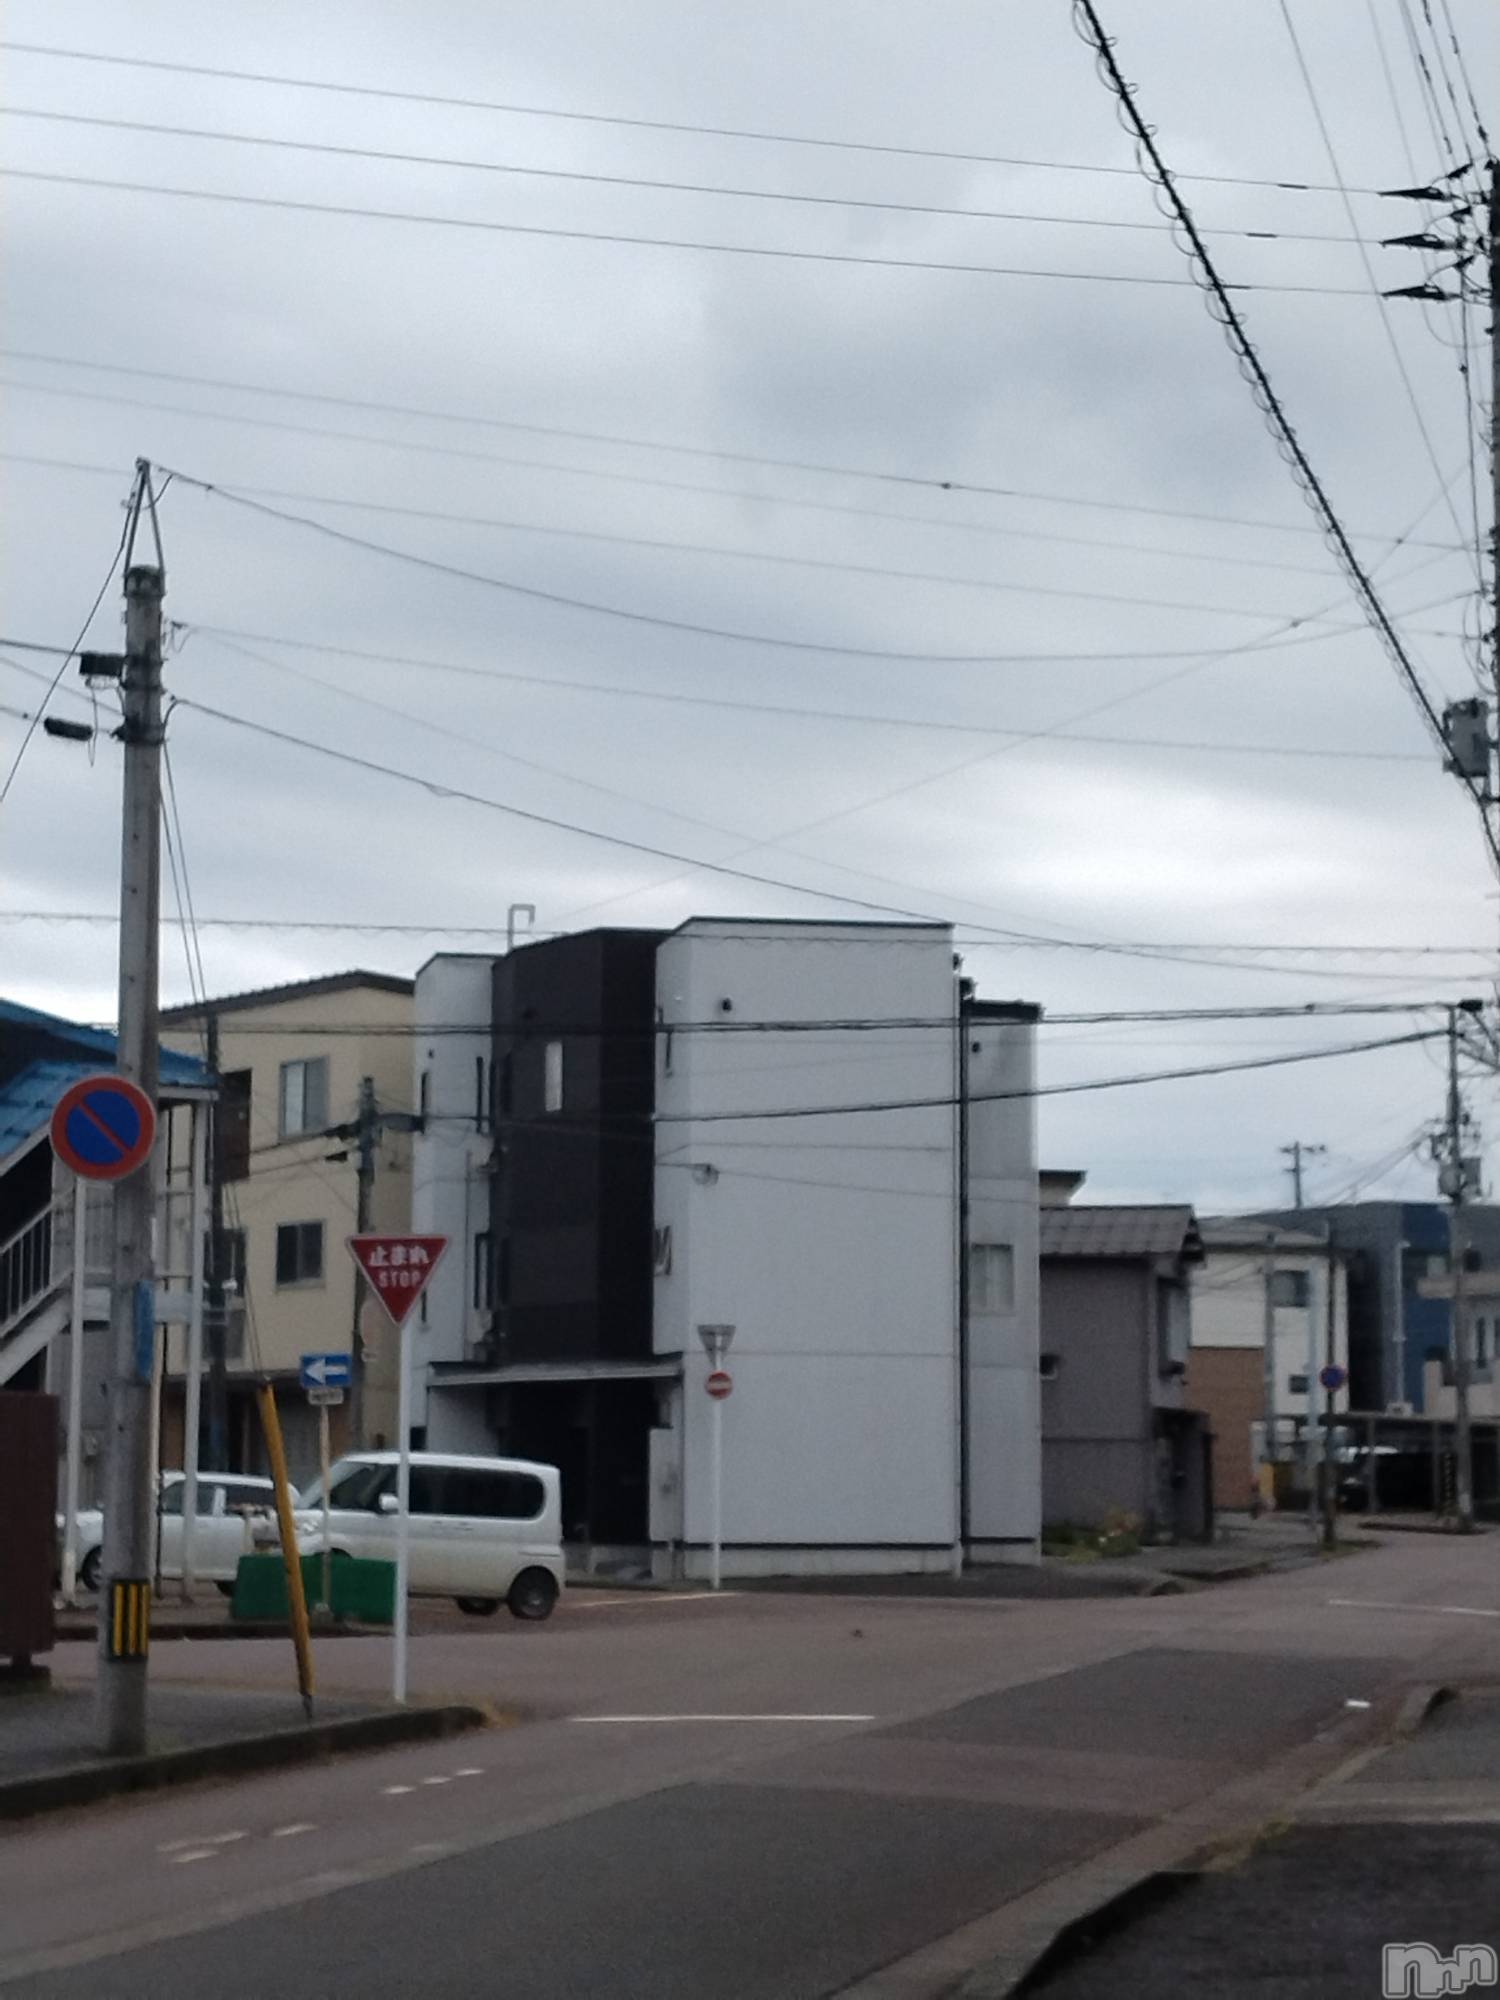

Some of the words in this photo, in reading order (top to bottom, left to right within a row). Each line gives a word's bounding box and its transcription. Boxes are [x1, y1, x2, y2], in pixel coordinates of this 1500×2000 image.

[368, 1244, 429, 1267] 止まれ
[379, 1271, 420, 1288] STOP
